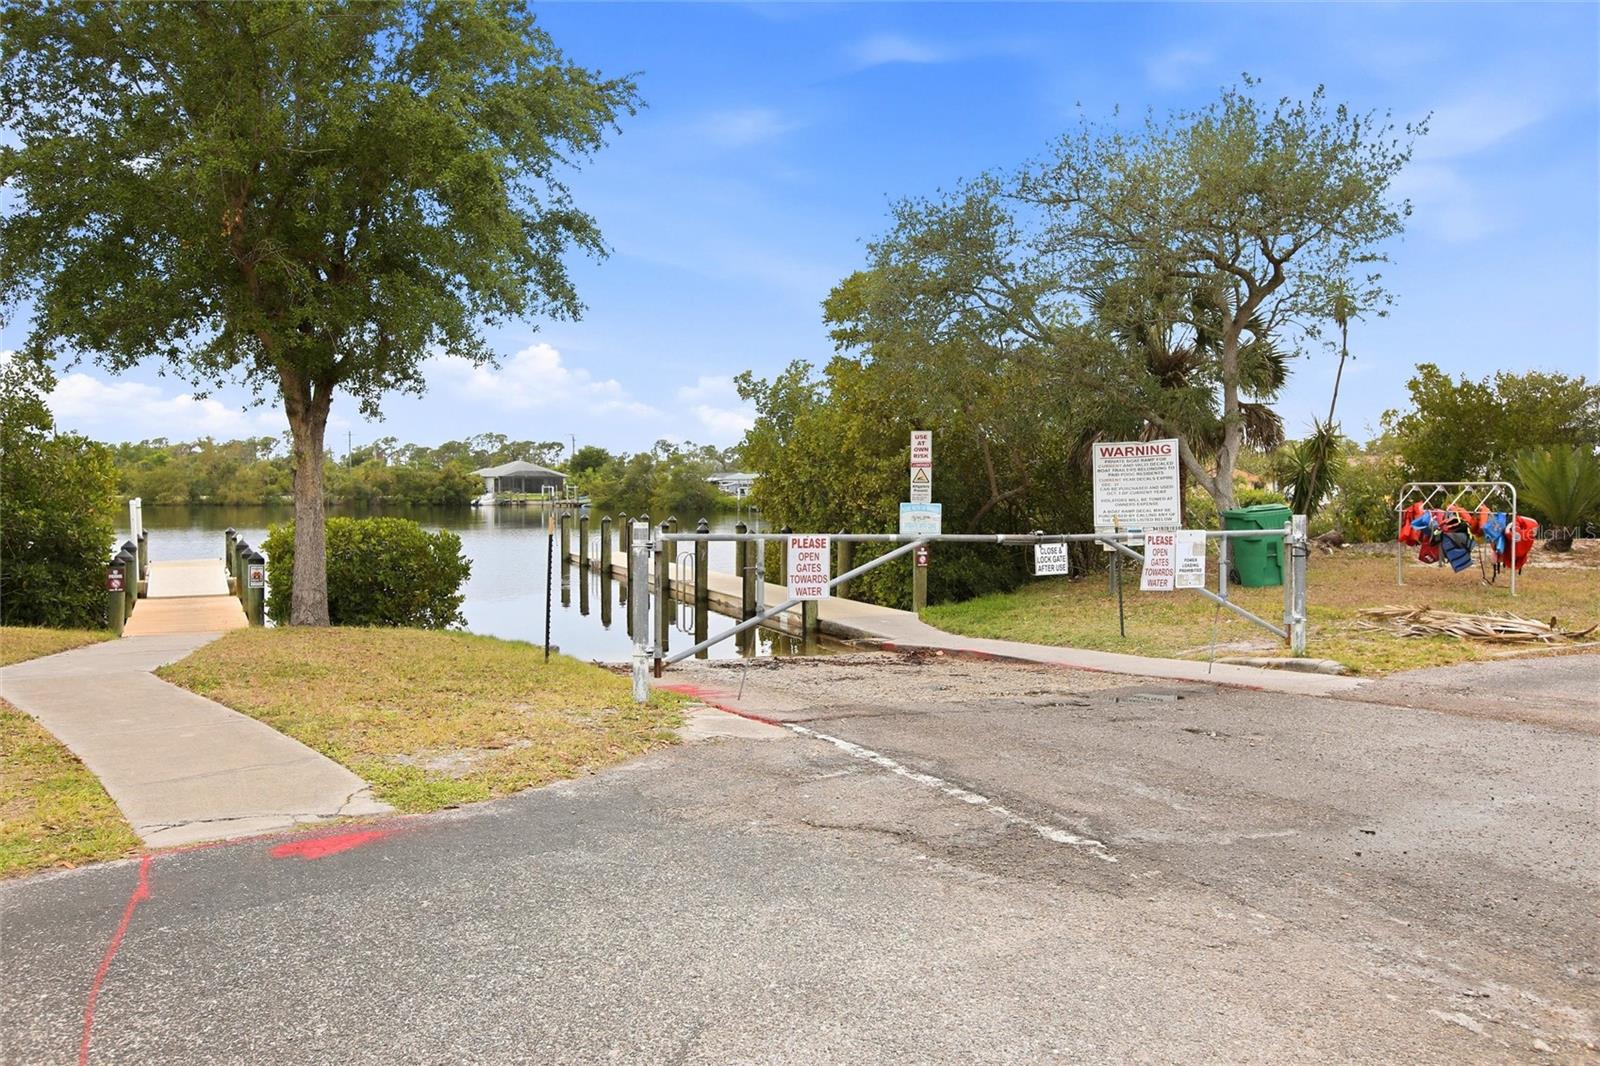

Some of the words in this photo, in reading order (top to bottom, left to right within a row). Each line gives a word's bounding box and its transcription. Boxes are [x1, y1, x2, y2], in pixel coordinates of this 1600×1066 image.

[1100, 444, 1171, 457] WARNING
[792, 538, 826, 548] PLEASE
[1148, 536, 1173, 545] PLEASE
[799, 552, 819, 561] OPEN
[796, 564, 821, 572] GATES
[1145, 568, 1173, 576] TOWARDS
[790, 575, 828, 584] TOWARDS
[796, 587, 822, 596] WATER
